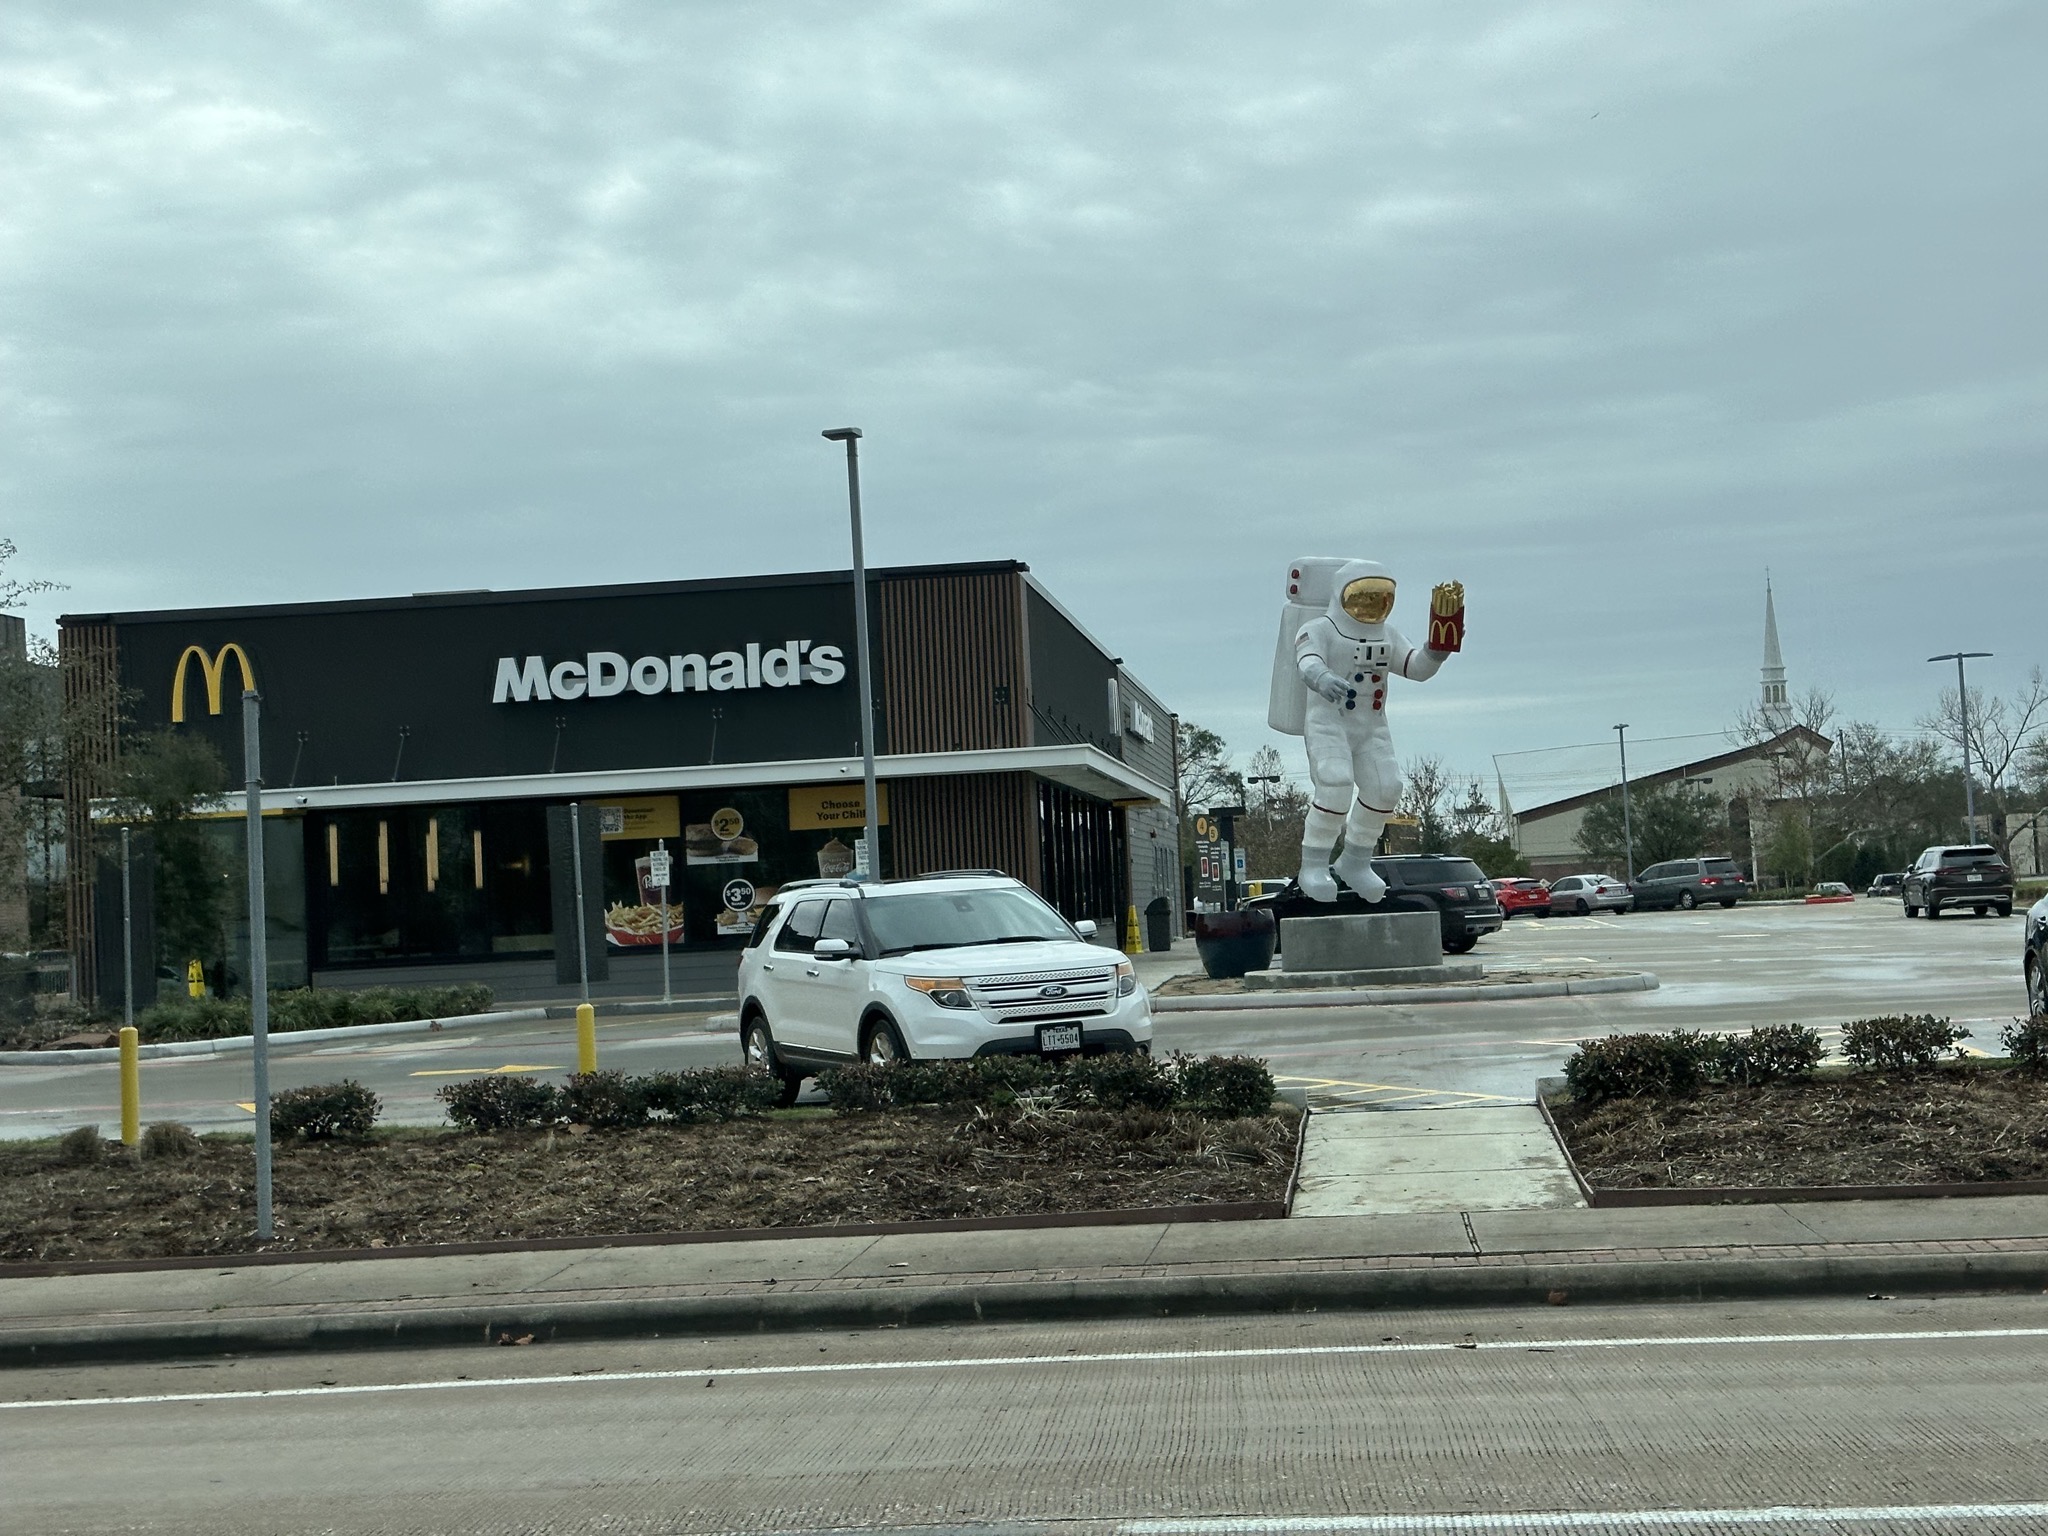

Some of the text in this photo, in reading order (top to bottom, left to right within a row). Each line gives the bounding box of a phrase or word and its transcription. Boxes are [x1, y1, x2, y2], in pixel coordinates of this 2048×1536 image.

[492, 639, 846, 703] McDonald's
[821, 800, 861, 809] Choose
[816, 811, 840, 820] Your
[1045, 986, 1062, 996] Ford
